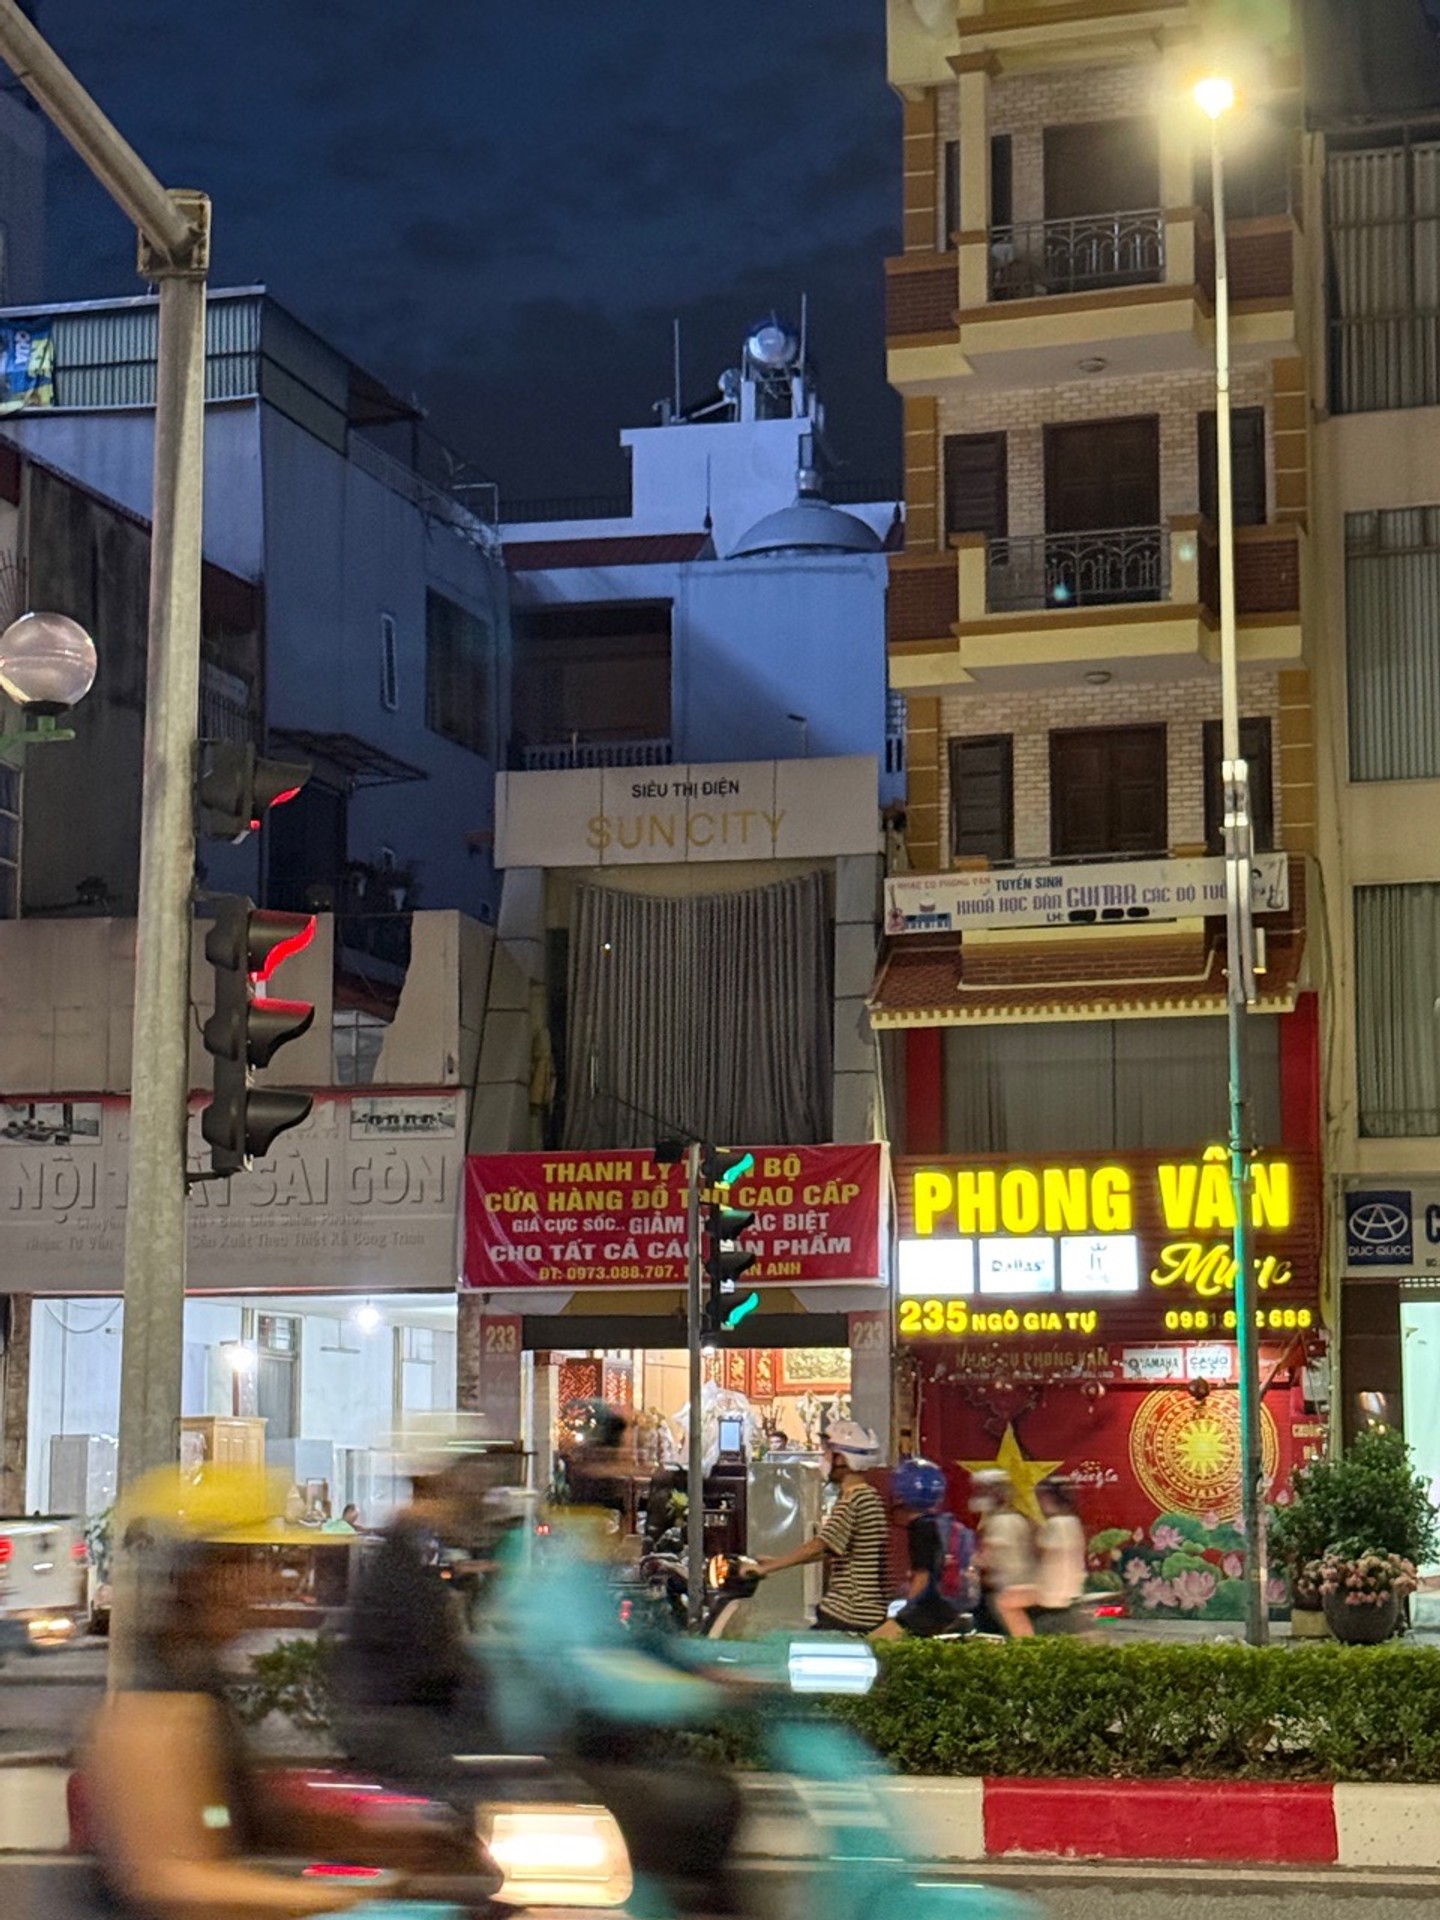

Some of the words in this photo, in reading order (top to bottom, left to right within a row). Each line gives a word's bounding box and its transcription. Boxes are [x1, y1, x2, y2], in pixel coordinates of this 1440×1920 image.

[631, 779, 668, 799] SIÊU
[673, 781, 698, 799] THỊ
[702, 776, 740, 798] ĐIỆN
[585, 813, 675, 850] SUN
[687, 808, 786, 846] CITY
[1035, 876, 1063, 888] SINH
[1000, 896, 1027, 914] HỌC
[1066, 884, 1137, 908] GUITAR
[542, 1161, 632, 1183] THANH
[764, 1153, 801, 1181] BỘ
[8, 1152, 96, 1224] NỘI
[250, 1149, 330, 1207] SÀI
[347, 1147, 446, 1205] GÒN
[485, 1186, 539, 1212] CỬA
[547, 1187, 623, 1212] HÀNG
[632, 1182, 669, 1209] ĐỒ
[739, 1186, 793, 1207] CAO
[802, 1178, 860, 1205] CẤP
[914, 1167, 1133, 1234] PHONG
[1158, 1146, 1290, 1229] VÂN
[544, 1217, 578, 1235] CỰC
[629, 1211, 684, 1234] GIẢM
[783, 1209, 829, 1234] BIỆT
[489, 1244, 542, 1262] CHO
[550, 1239, 597, 1260] TẤT
[603, 1238, 639, 1259] CẢ
[773, 1233, 851, 1256] PHẨM
[1348, 1245, 1374, 1256] DUC
[1375, 1245, 1411, 1255] QUOC
[767, 1261, 801, 1275] ANH
[1151, 1242, 1292, 1295] Muic
[899, 1300, 968, 1332] 235
[972, 1309, 1020, 1331] NGÔ
[1023, 1311, 1062, 1331] GIA
[1065, 1309, 1098, 1333] TỰ
[1222, 1310, 1265, 1328] 82
[1268, 1309, 1311, 1328] 688
[485, 1324, 516, 1353] 233
[852, 1321, 884, 1350] 233
[1023, 1351, 1074, 1367] PHONG
[1141, 1357, 1179, 1369] YAMAHA
